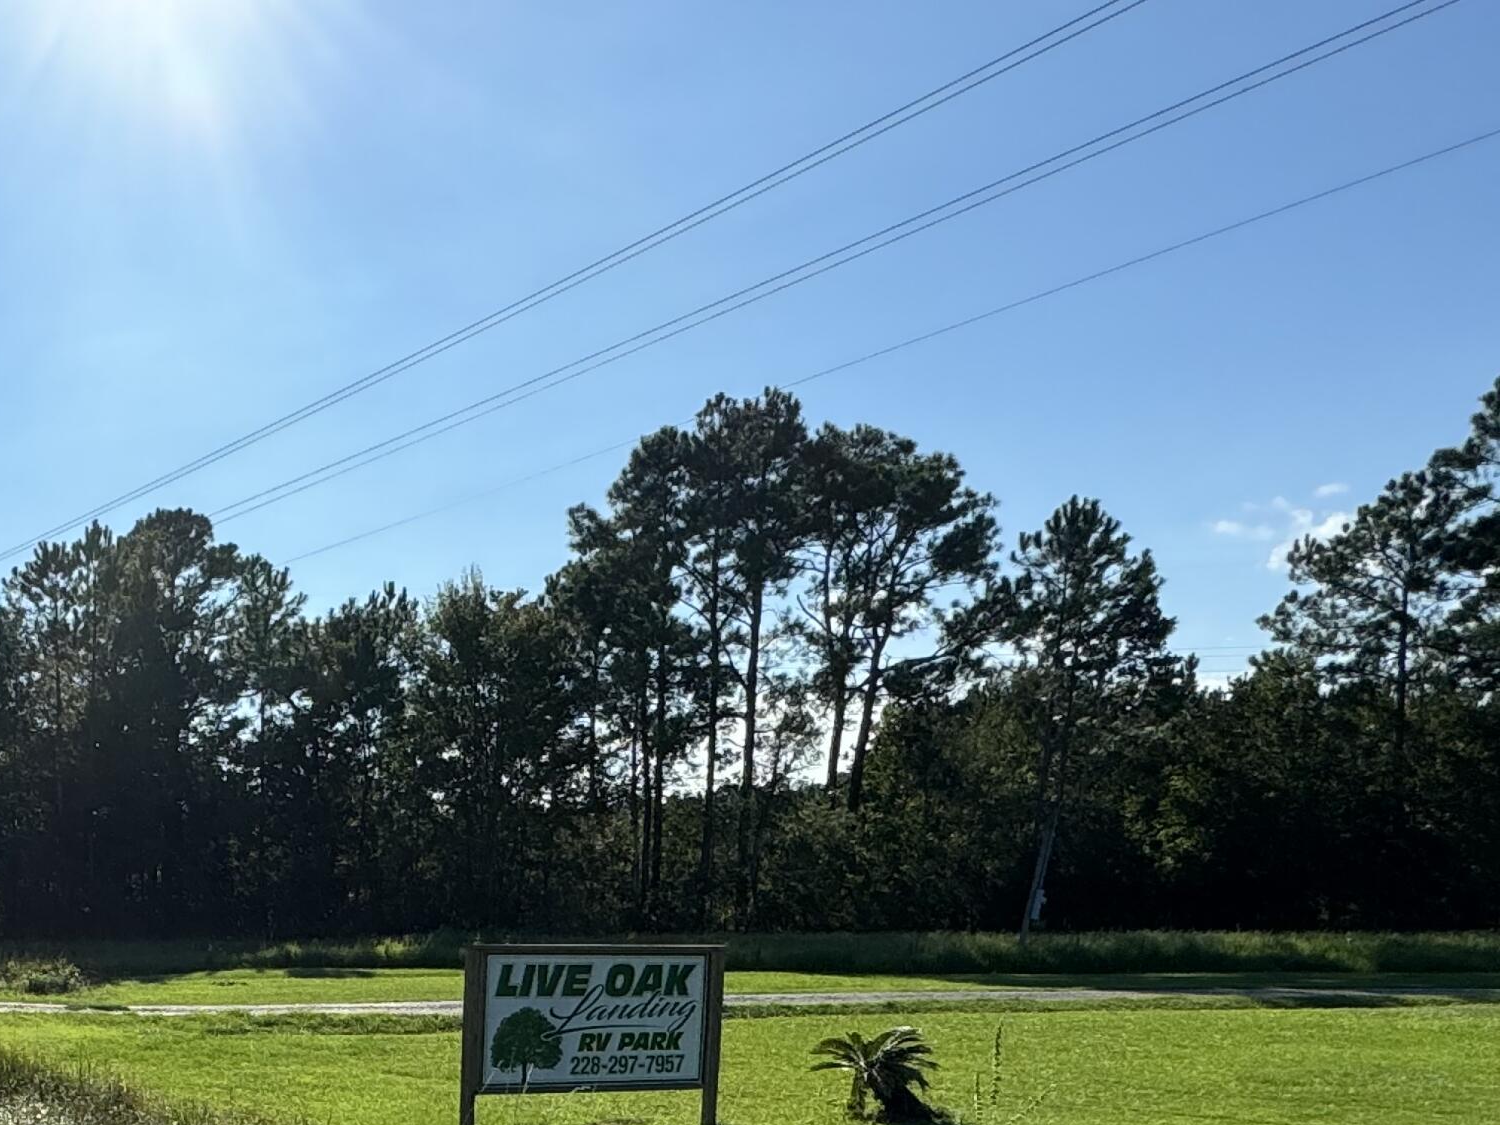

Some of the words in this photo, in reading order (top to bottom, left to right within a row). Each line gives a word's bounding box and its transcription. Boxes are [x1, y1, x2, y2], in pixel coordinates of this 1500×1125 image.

[494, 964, 594, 997] LIVE
[604, 963, 697, 997] OAK
[541, 984, 697, 1040] Landing
[577, 1032, 613, 1052] RV
[617, 1031, 683, 1051] PARK
[569, 1054, 685, 1076] 228-297-7957
